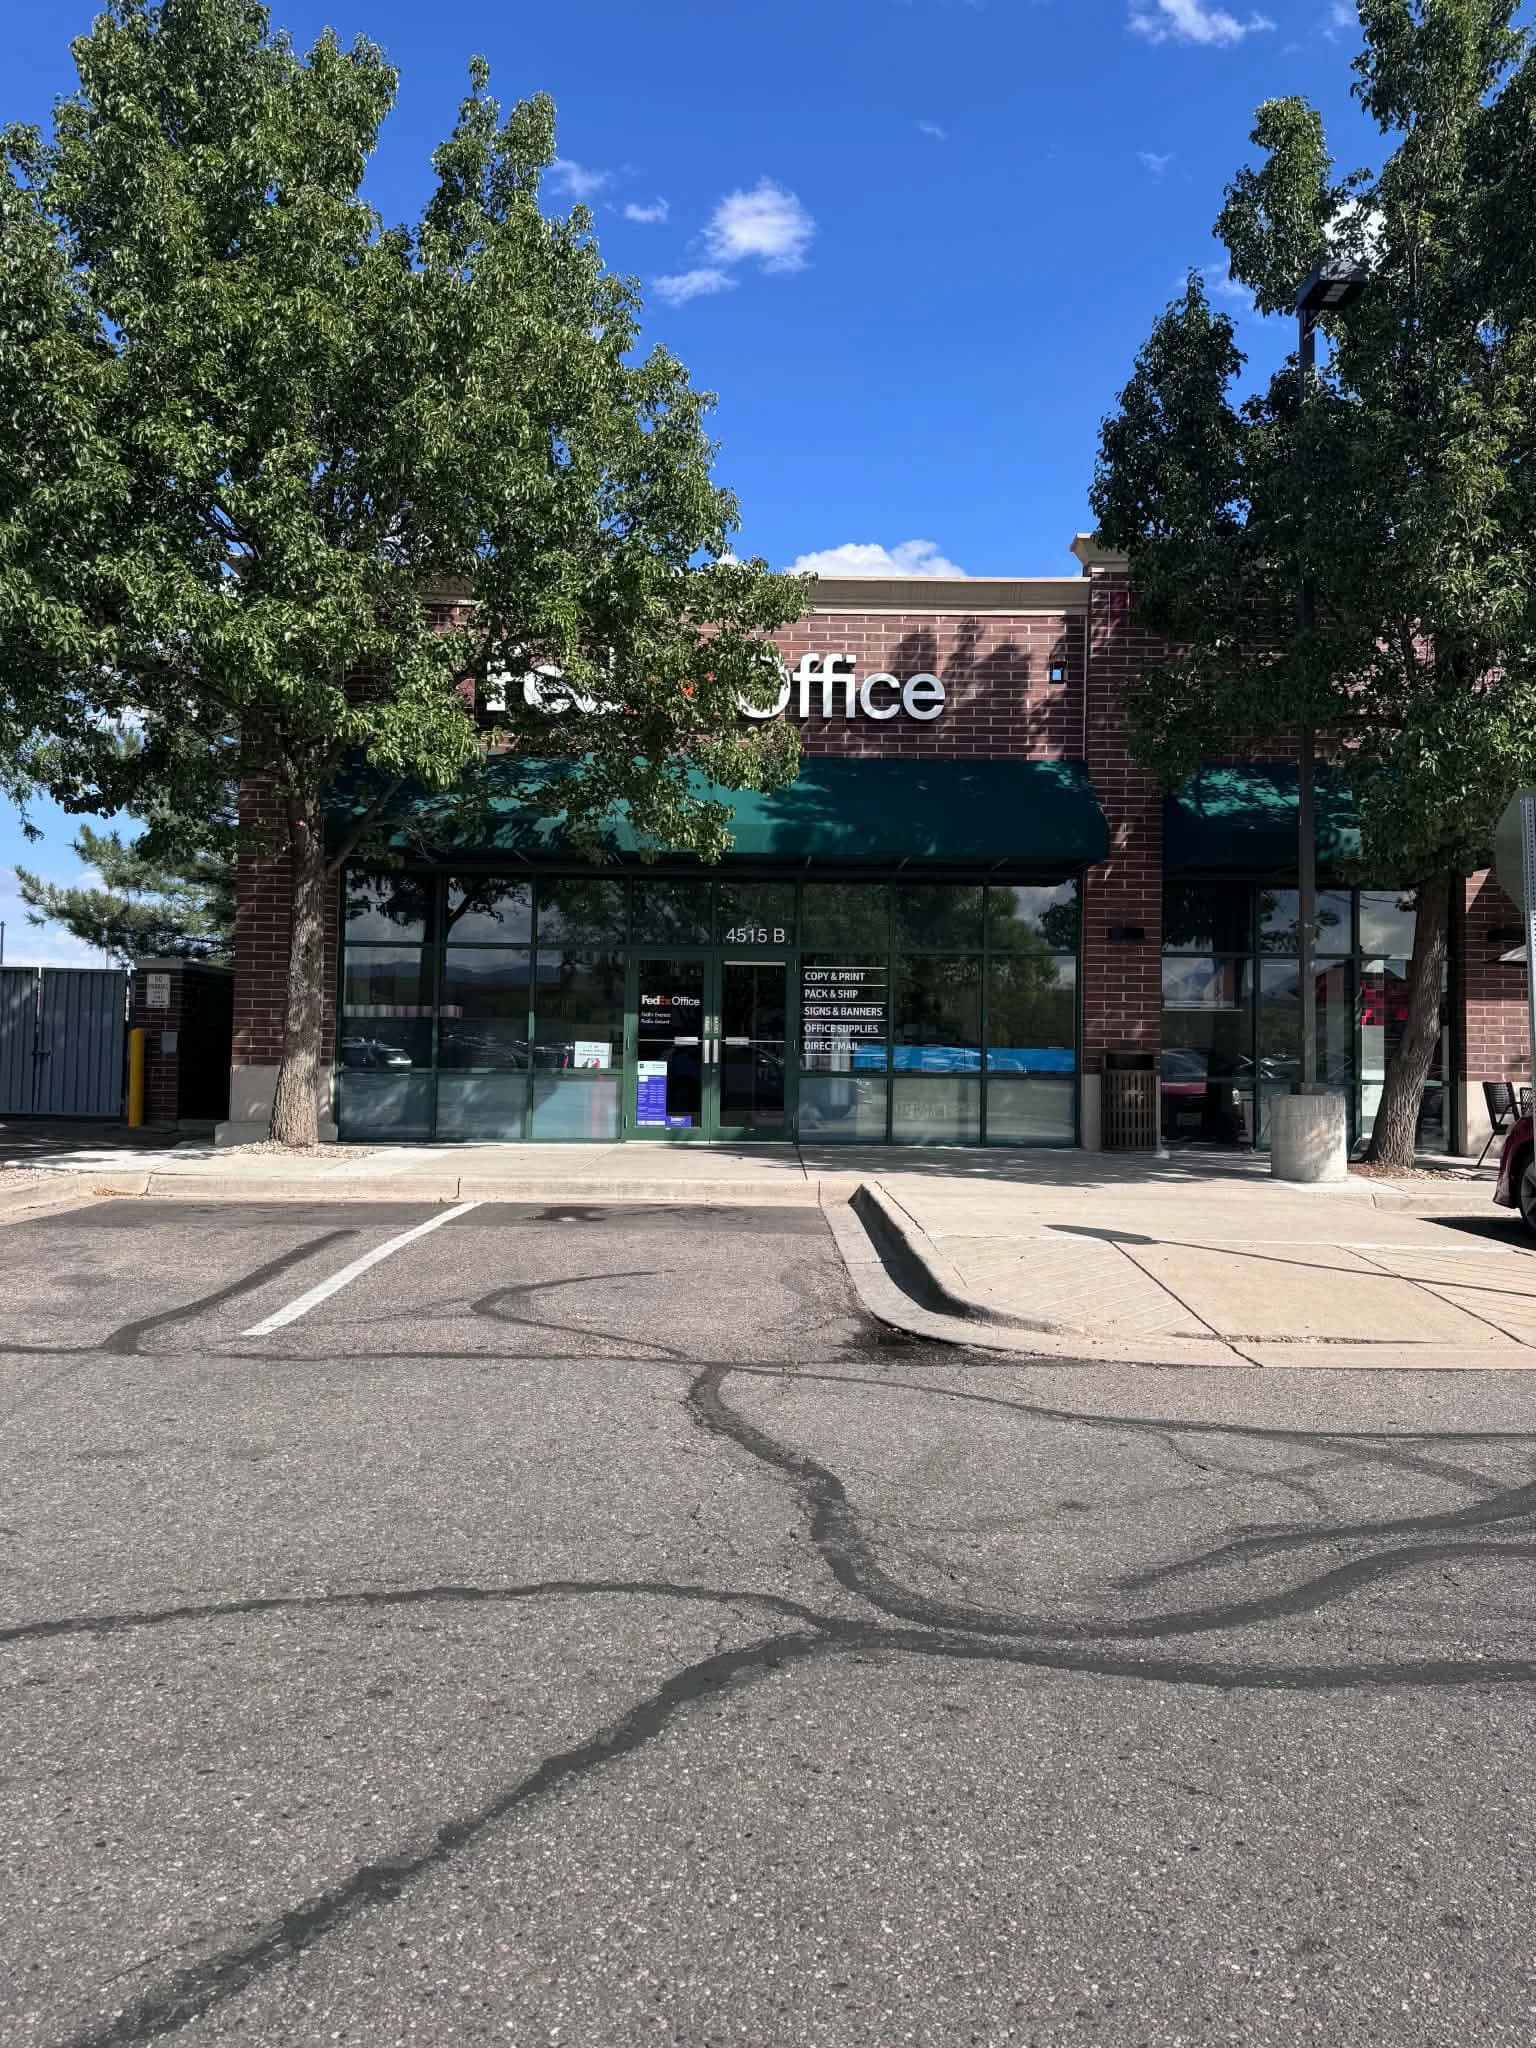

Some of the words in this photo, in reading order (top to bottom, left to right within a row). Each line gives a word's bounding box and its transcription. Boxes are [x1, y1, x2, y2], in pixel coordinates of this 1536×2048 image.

[735, 653, 946, 720] Office
[726, 928, 767, 943] 4515
[773, 928, 785, 943] B
[804, 972, 829, 981] COPY
[830, 972, 838, 981] &
[839, 972, 865, 981] PRINT
[804, 989, 828, 999] PACK
[829, 989, 837, 999] &
[838, 989, 859, 999] SHIP
[641, 994, 672, 1005] FedEx
[672, 996, 701, 1006] Office
[803, 1006, 831, 1016] SIGNS
[832, 1007, 839, 1016] &
[840, 1007, 883, 1016] BANNERS
[804, 1023, 837, 1033] OFFICE
[837, 1024, 879, 1033] SUPPLIES
[803, 1041, 838, 1051] DIRECT
[838, 1042, 860, 1051] MAIL
